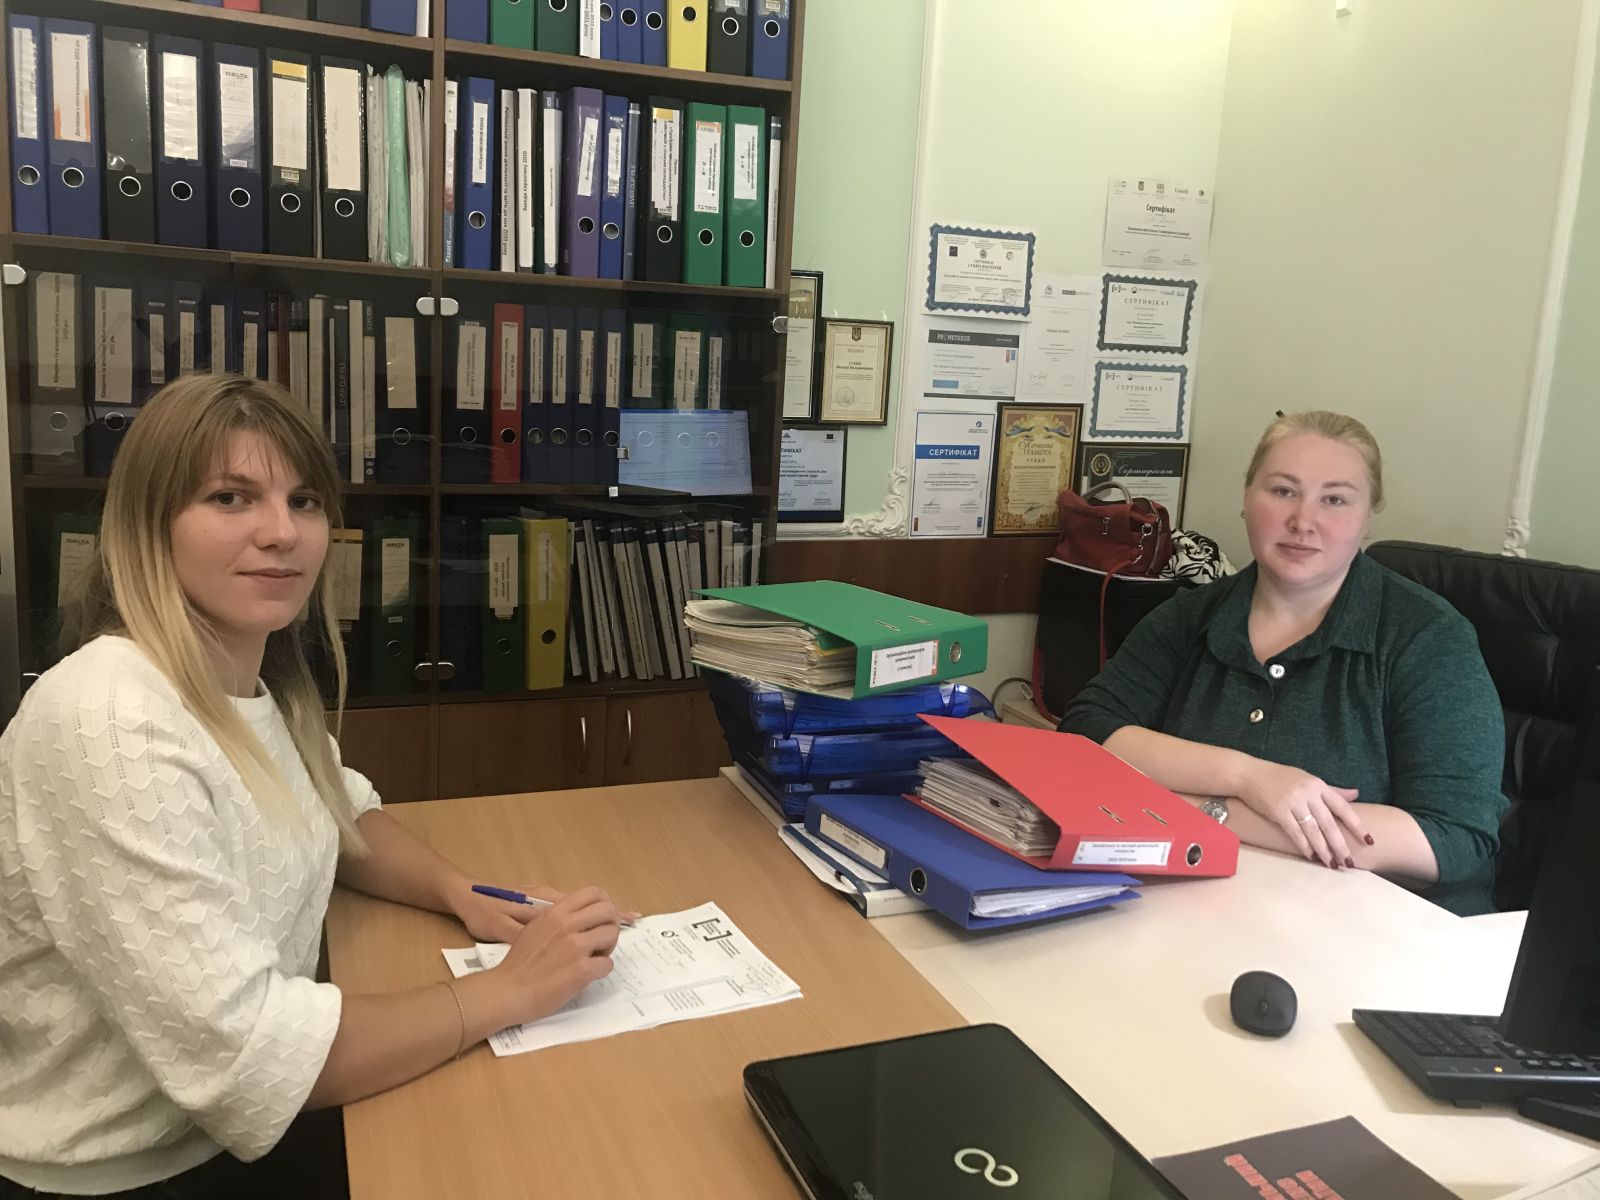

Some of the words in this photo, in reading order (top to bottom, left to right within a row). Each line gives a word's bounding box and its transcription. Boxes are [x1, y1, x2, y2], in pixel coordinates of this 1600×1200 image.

[225, 71, 249, 80] DELTA
[1146, 203, 1176, 214] Сертифікат
[1124, 298, 1170, 306] СЕРТИФІКАТ
[1116, 384, 1163, 392] СЕРТИФІКАТ
[928, 448, 978, 457] СЕРТИФІКАТ
[1114, 457, 1174, 477] Сертифікат
